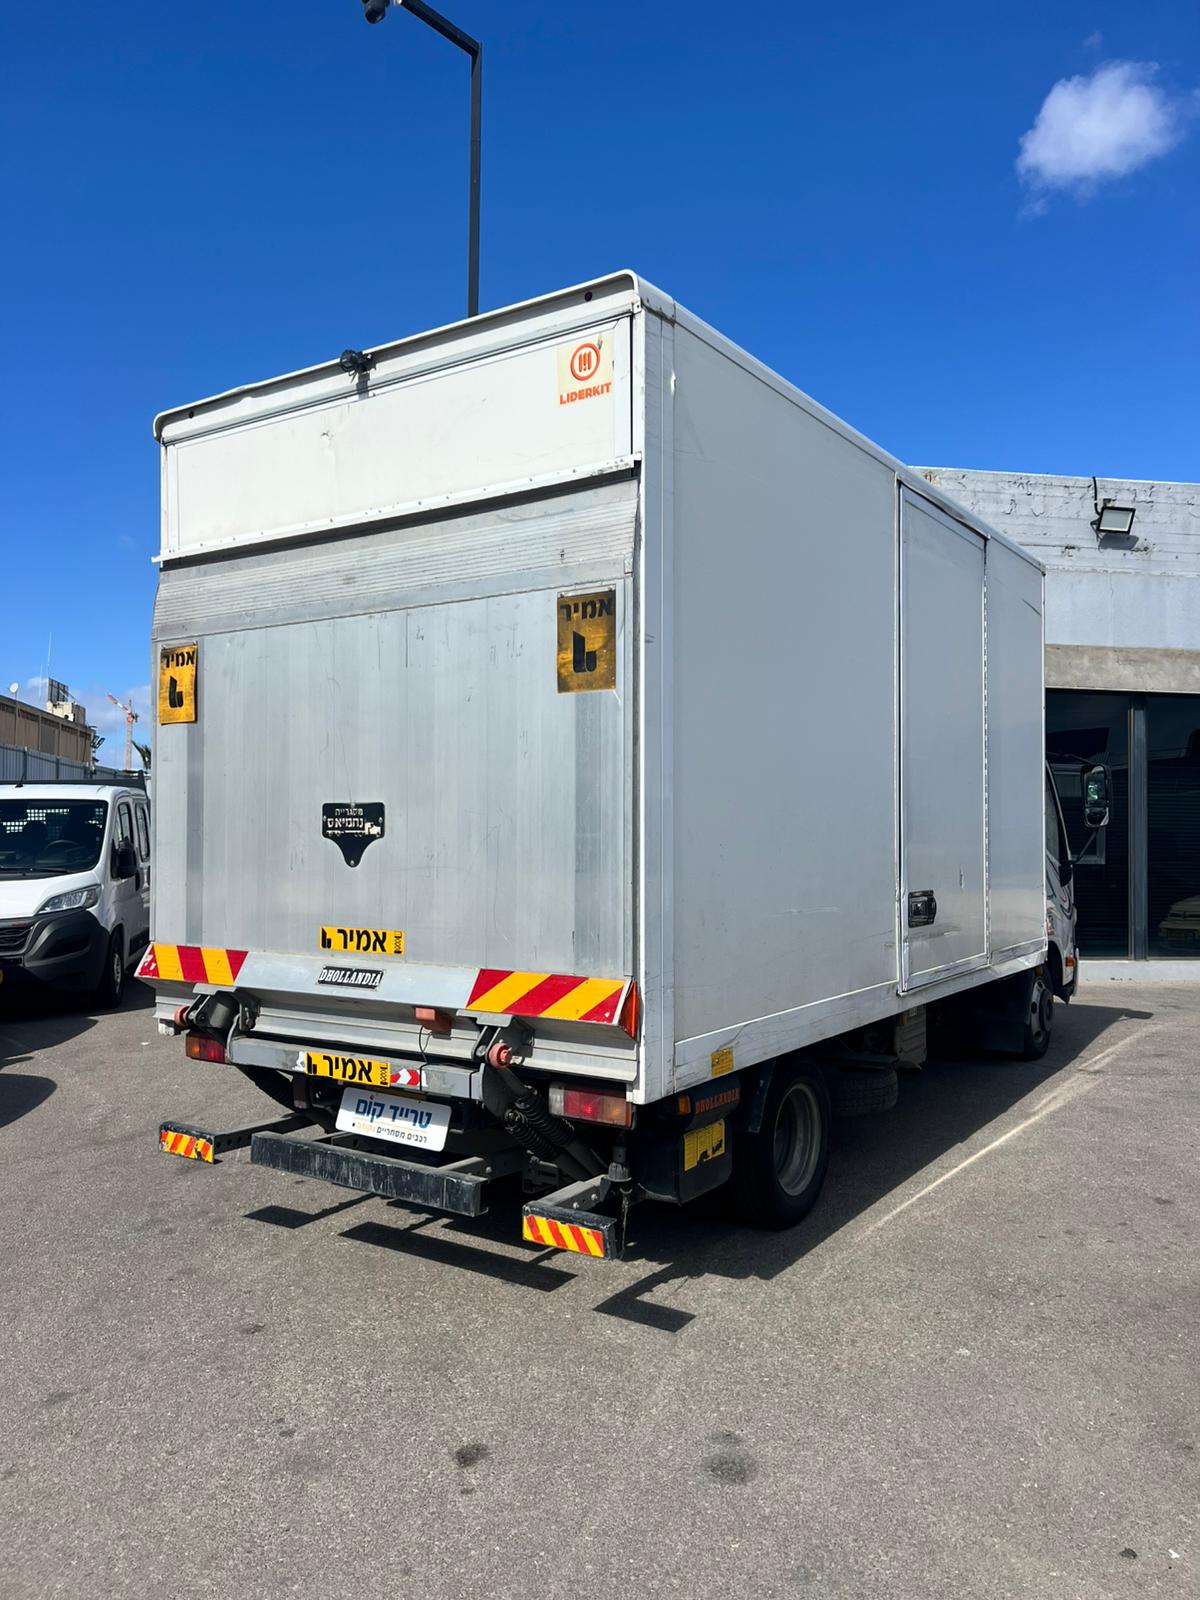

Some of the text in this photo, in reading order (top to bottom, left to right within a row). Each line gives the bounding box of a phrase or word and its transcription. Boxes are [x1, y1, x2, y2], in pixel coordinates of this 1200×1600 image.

[560, 382, 612, 405] LIDERKIT
[560, 597, 613, 623] אמיר
[161, 651, 195, 669] אמיר
[337, 928, 386, 952] אמיר
[320, 970, 381, 986] DHOLLANDIA
[323, 1055, 372, 1082] אמיר
[355, 1099, 433, 1128] טרייד קום
[376, 1126, 406, 1139] מסחריים
[407, 1133, 427, 1144] רכבים
